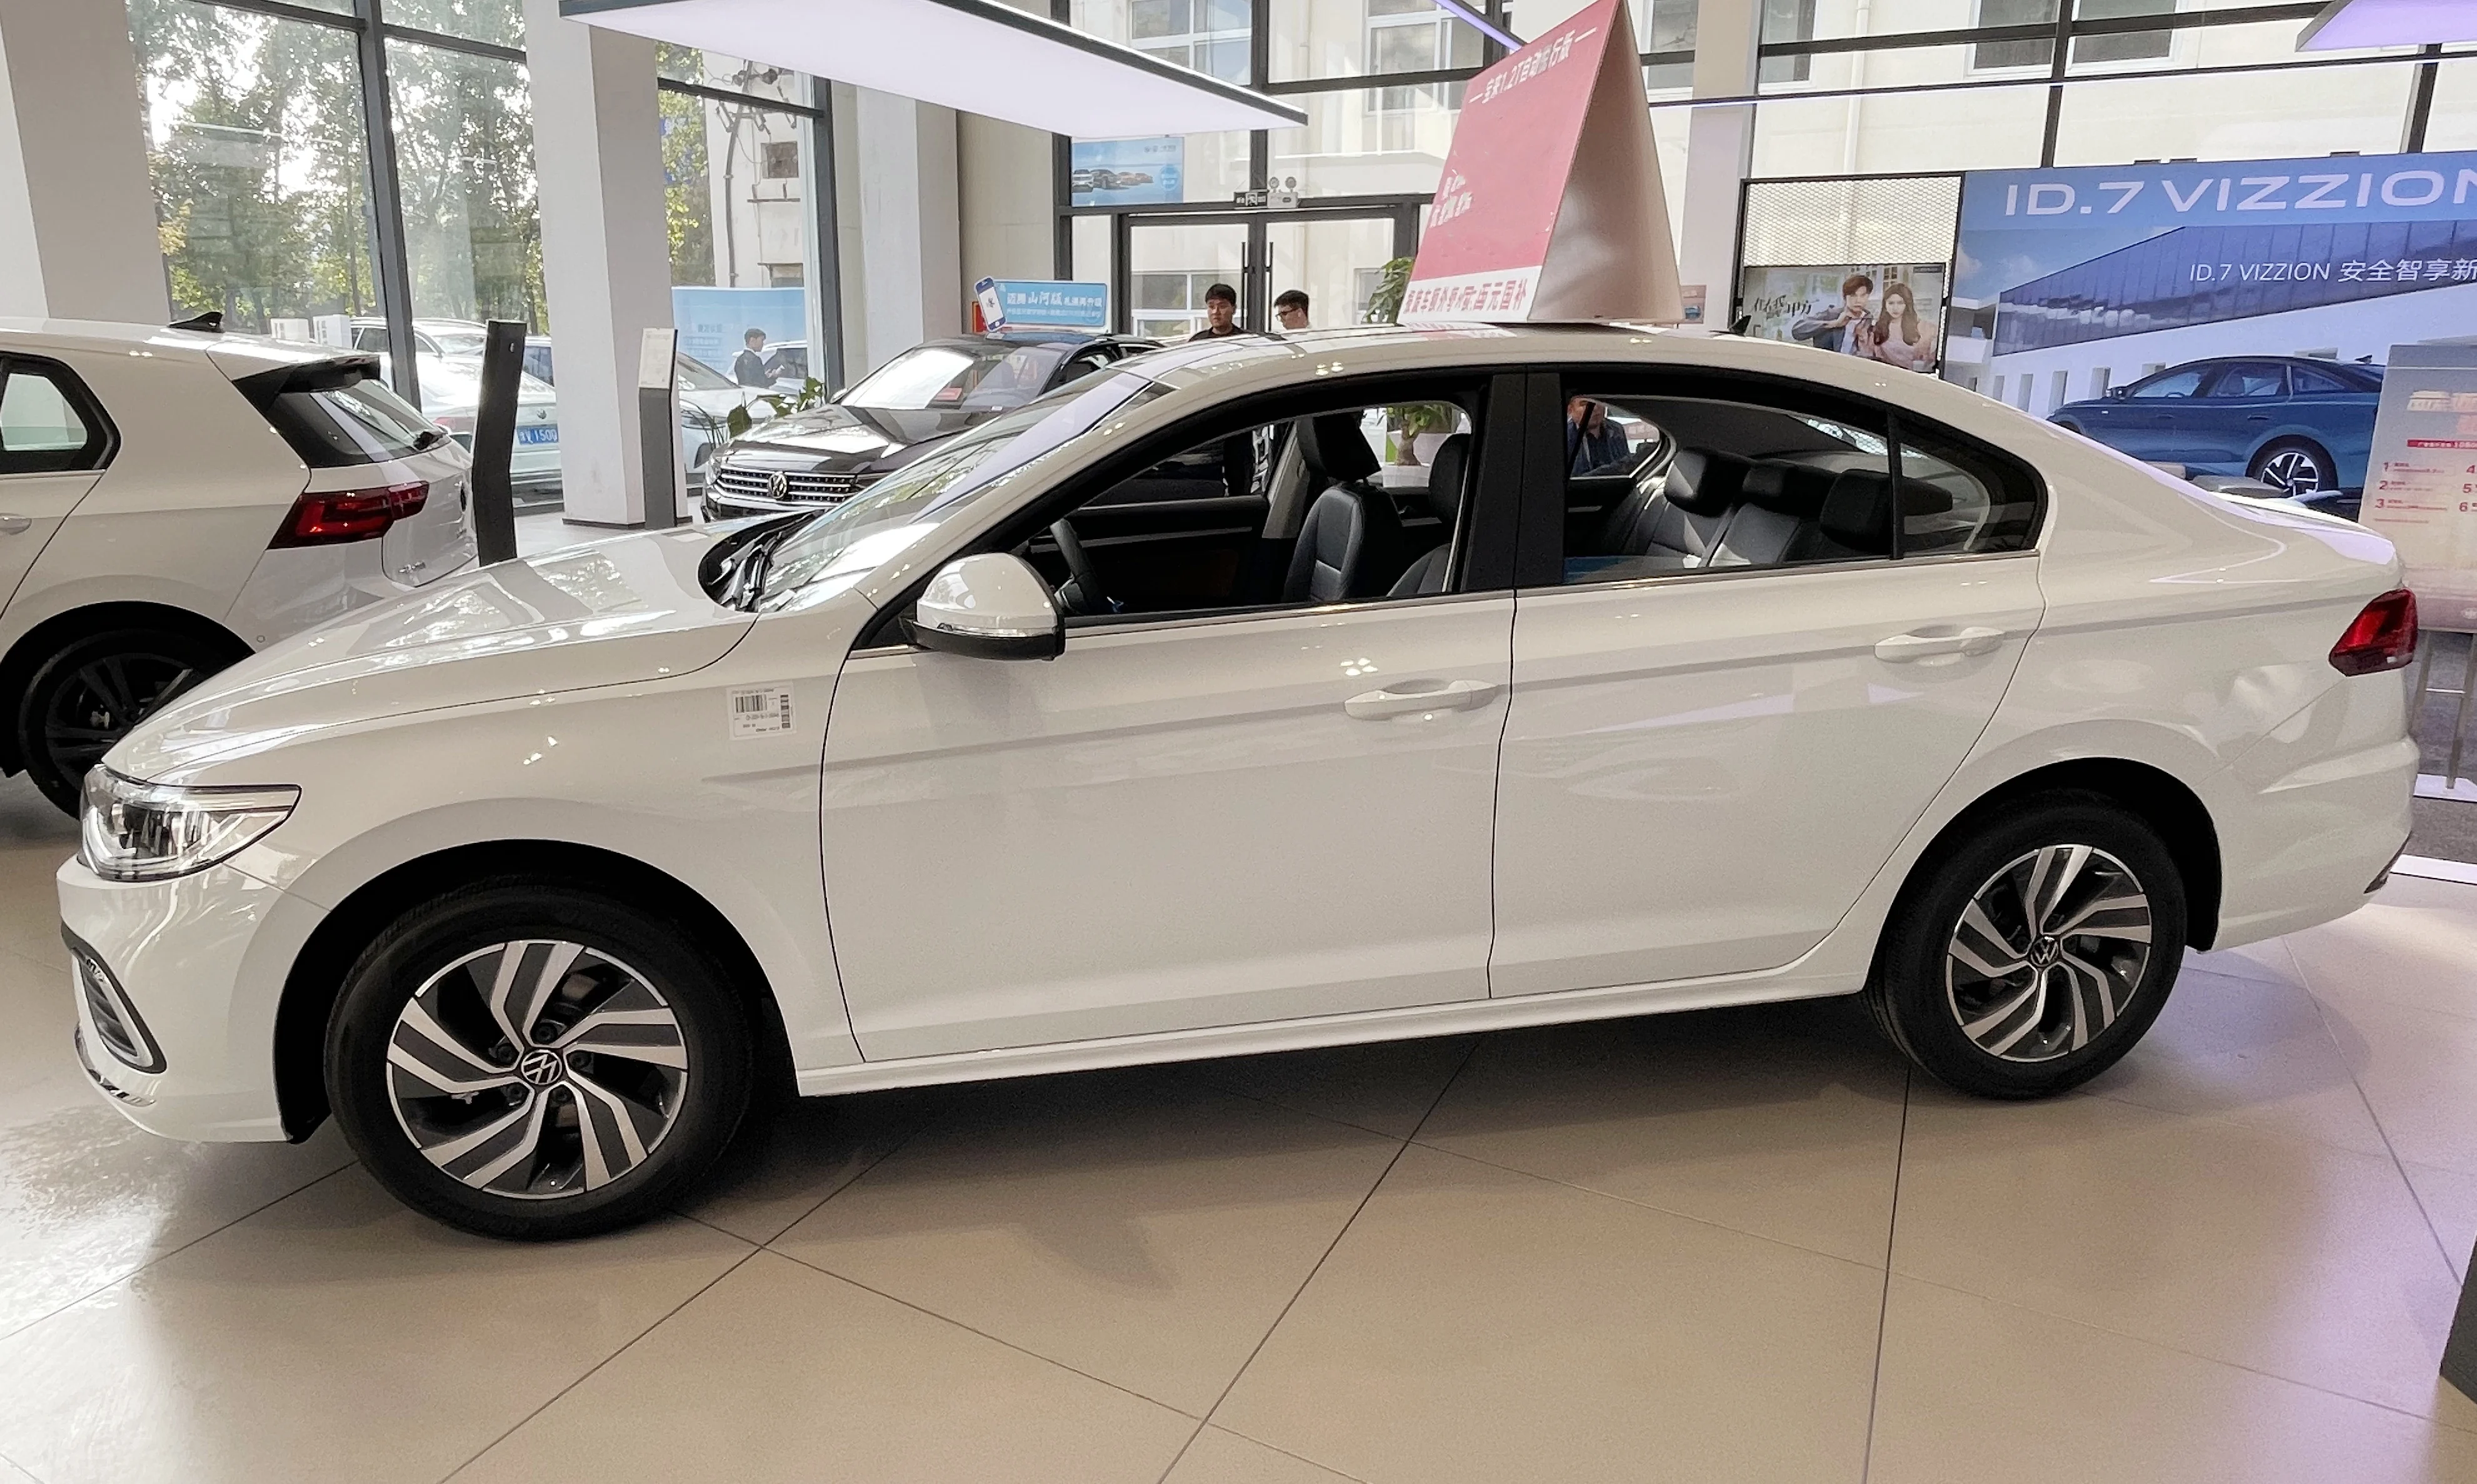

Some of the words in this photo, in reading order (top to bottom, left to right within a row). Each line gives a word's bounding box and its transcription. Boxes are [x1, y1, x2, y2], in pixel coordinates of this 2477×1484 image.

[2004, 180, 2144, 217] ID.7
[2189, 264, 2232, 282] ID.7
[2239, 262, 2330, 282] VIZZION
[2338, 257, 2477, 282] 安全智享新
[2379, 480, 2388, 490] 2
[2463, 483, 2473, 494] 5
[2374, 499, 2385, 509] 3
[2459, 501, 2468, 512] 6
